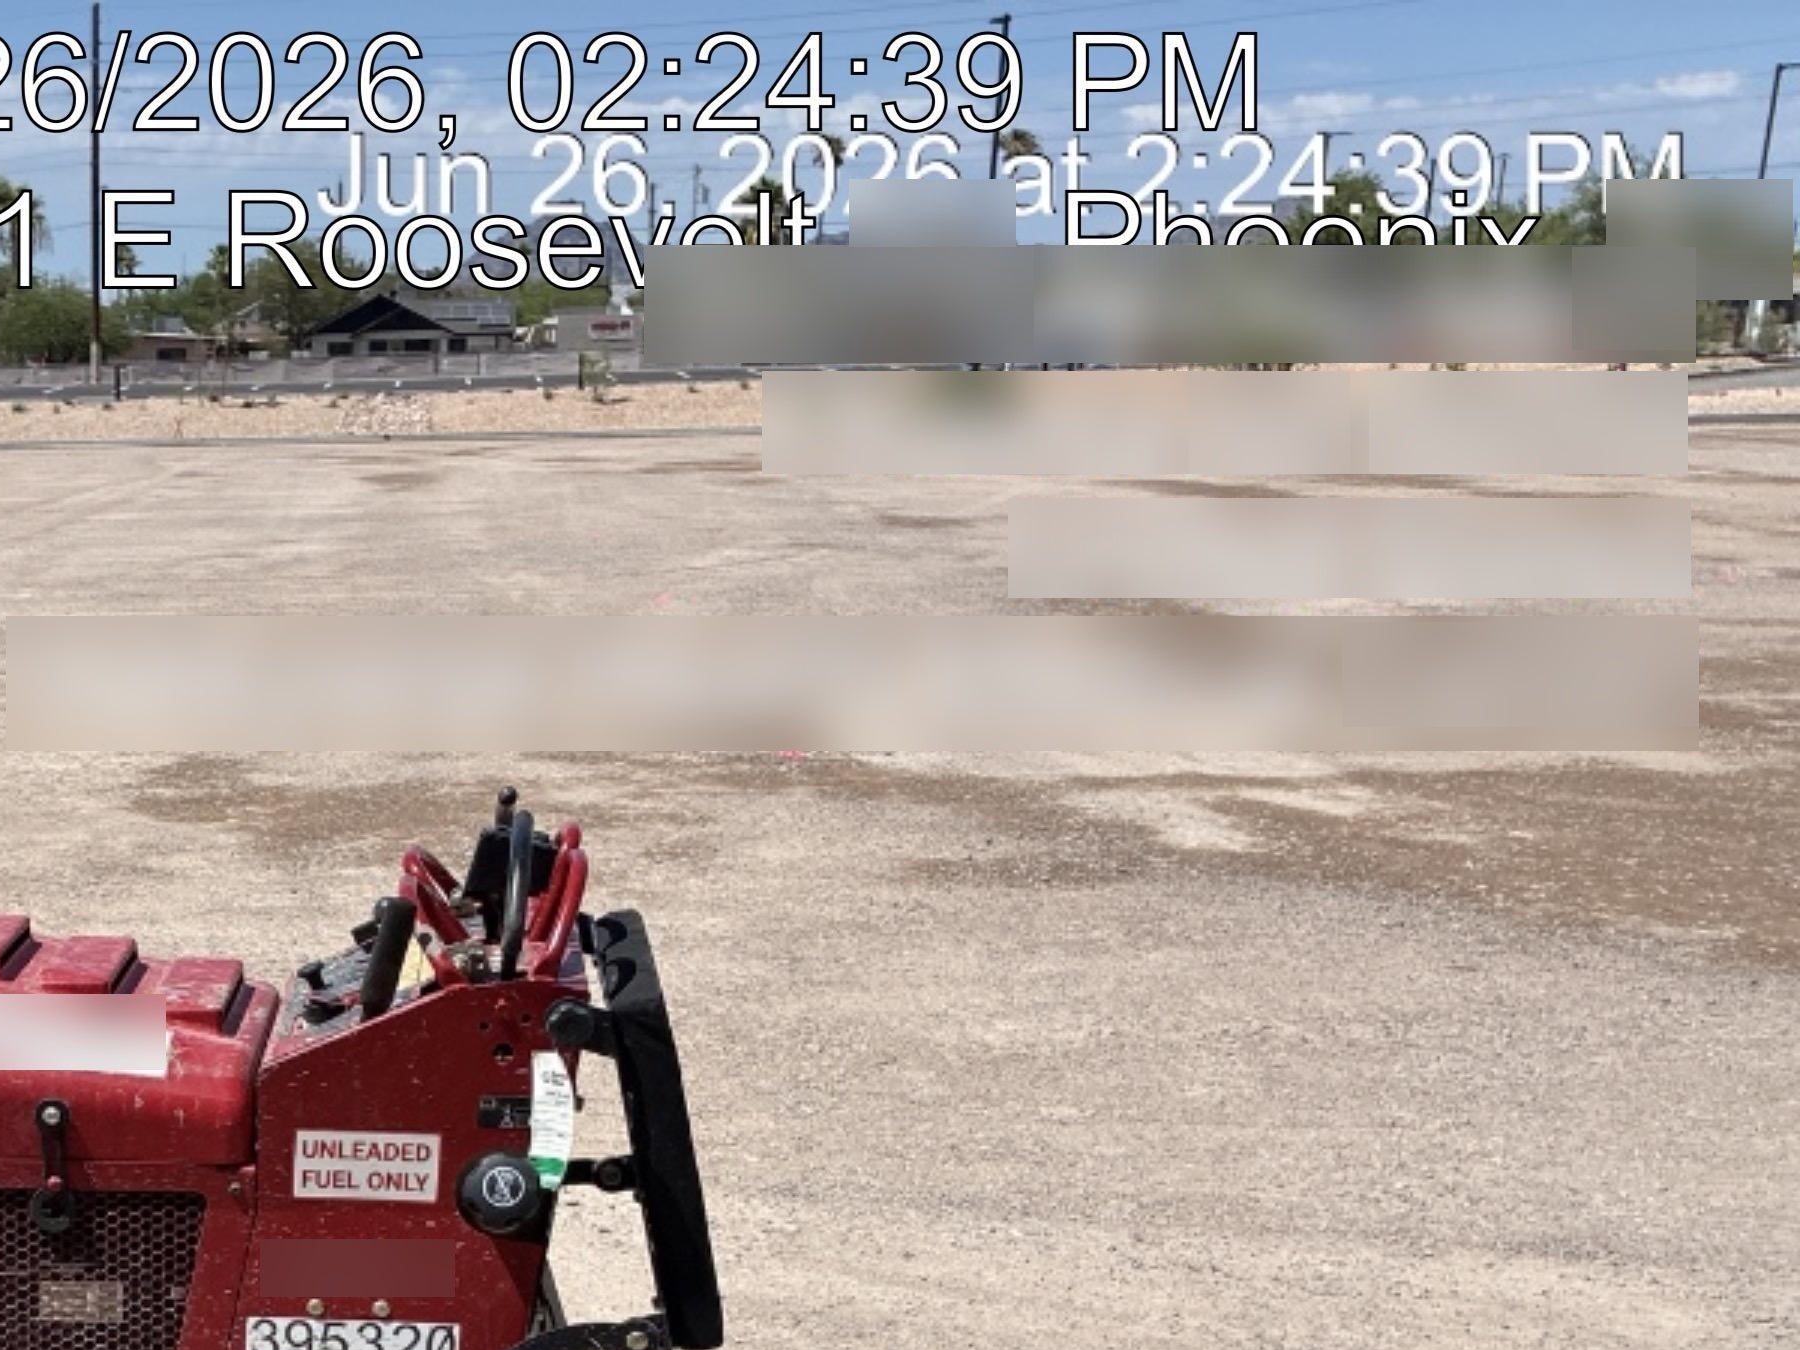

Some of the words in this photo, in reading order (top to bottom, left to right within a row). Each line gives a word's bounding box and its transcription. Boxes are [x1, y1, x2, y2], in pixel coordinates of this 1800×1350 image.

[302, 1139, 432, 1163] UNLEADED
[301, 1169, 360, 1190] FUEL
[368, 1171, 431, 1192] ONLY
